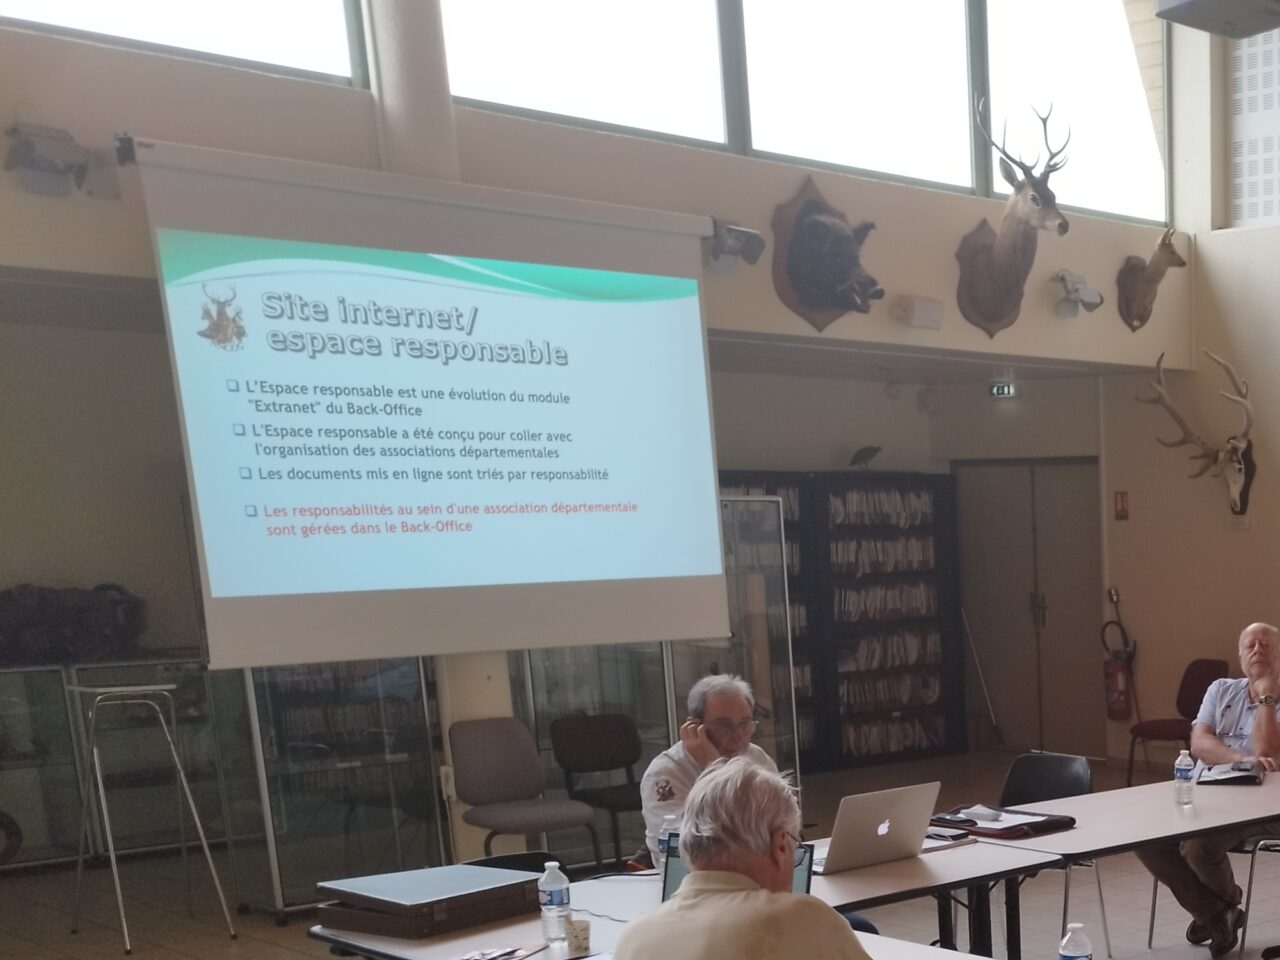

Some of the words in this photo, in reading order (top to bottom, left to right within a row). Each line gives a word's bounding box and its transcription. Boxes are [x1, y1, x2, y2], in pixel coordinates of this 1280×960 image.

[261, 290, 328, 322] Site
[337, 296, 478, 336] internet/
[266, 329, 382, 359] espace
[391, 335, 569, 366] responsable
[245, 380, 308, 397] L'Espace
[313, 384, 394, 399] responsable
[398, 388, 418, 399] est
[421, 389, 445, 399] une
[449, 387, 506, 402] évolution
[509, 390, 524, 403] du
[528, 392, 570, 404] module
[248, 399, 321, 414] "Extranet"
[326, 402, 343, 414] du
[347, 402, 422, 416] Back-Office
[252, 424, 313, 440] L'Espace
[318, 426, 397, 440] responsable
[402, 430, 409, 439] a
[413, 427, 434, 439] été
[438, 429, 474, 443] conçu
[479, 431, 505, 443] pour
[510, 430, 542, 441] coller
[547, 432, 573, 442] avec
[255, 443, 349, 459] l'organisation
[353, 444, 375, 456] des
[380, 445, 455, 457] associations
[459, 445, 560, 460] départementales
[258, 467, 283, 480] Les
[287, 467, 362, 480] documents
[366, 468, 388, 480] mis
[392, 470, 409, 480] en
[413, 467, 443, 483] ligne
[447, 469, 473, 480] sont
[477, 468, 504, 480] triés
[508, 470, 527, 482] par
[531, 468, 609, 483] responsabilité
[263, 505, 288, 518] Les
[292, 504, 393, 519] responsabilités
[397, 506, 413, 516] au
[417, 503, 442, 515] sein
[446, 503, 480, 514] d'une
[484, 502, 548, 514] association
[552, 501, 639, 515] départementale
[266, 525, 296, 536] sont
[301, 523, 346, 539] gérées
[351, 522, 381, 534] dans
[385, 522, 397, 533] le
[401, 520, 473, 534] Back-Office
